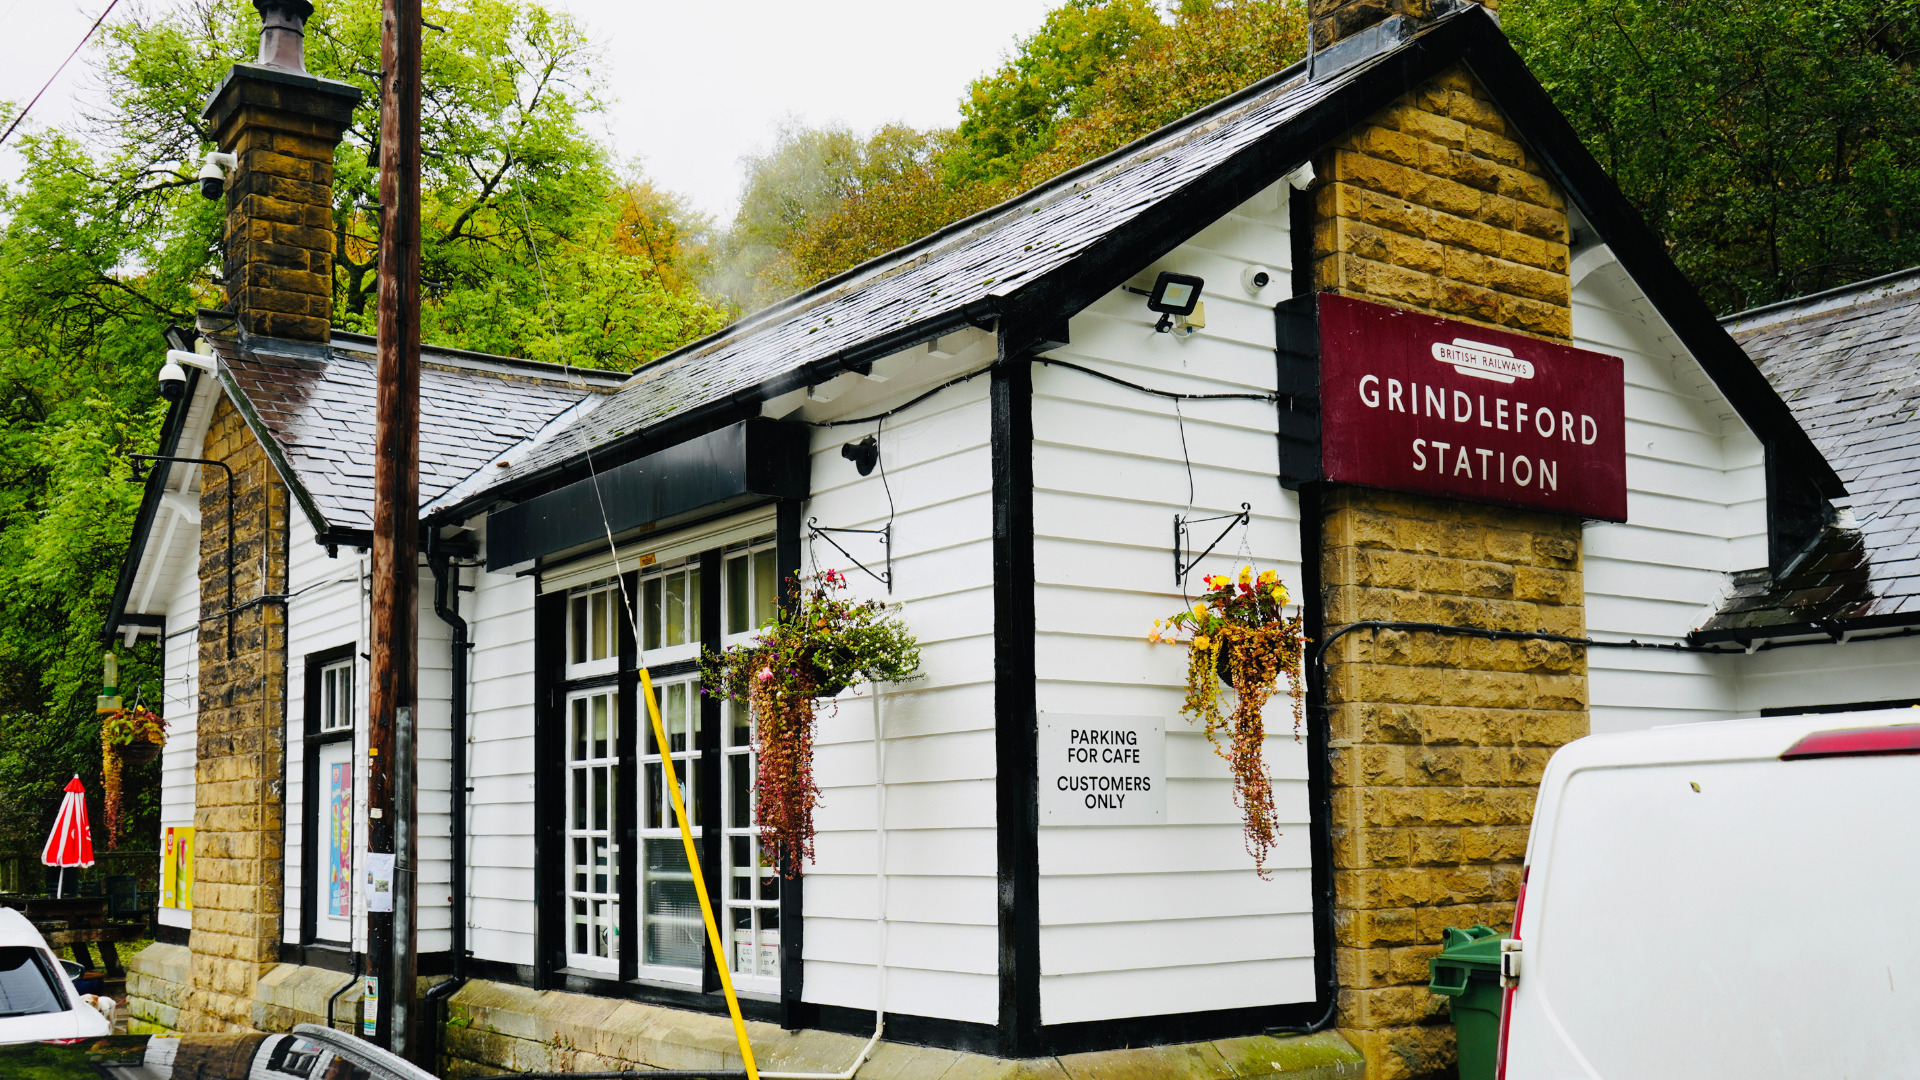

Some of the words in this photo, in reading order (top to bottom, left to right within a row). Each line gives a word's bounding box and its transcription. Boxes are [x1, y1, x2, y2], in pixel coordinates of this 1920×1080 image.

[1440, 347, 1477, 364] BRITISH
[1482, 356, 1527, 374] RAILWAYS
[1359, 374, 1598, 445] GRINDLEFORD
[1412, 438, 1557, 491] STATION
[1070, 729, 1137, 745] PARKING
[1068, 748, 1097, 763] FOR
[1102, 748, 1140, 763] CAFE
[1057, 776, 1151, 791] CUSTOMERS
[1085, 794, 1125, 809] ONLY
